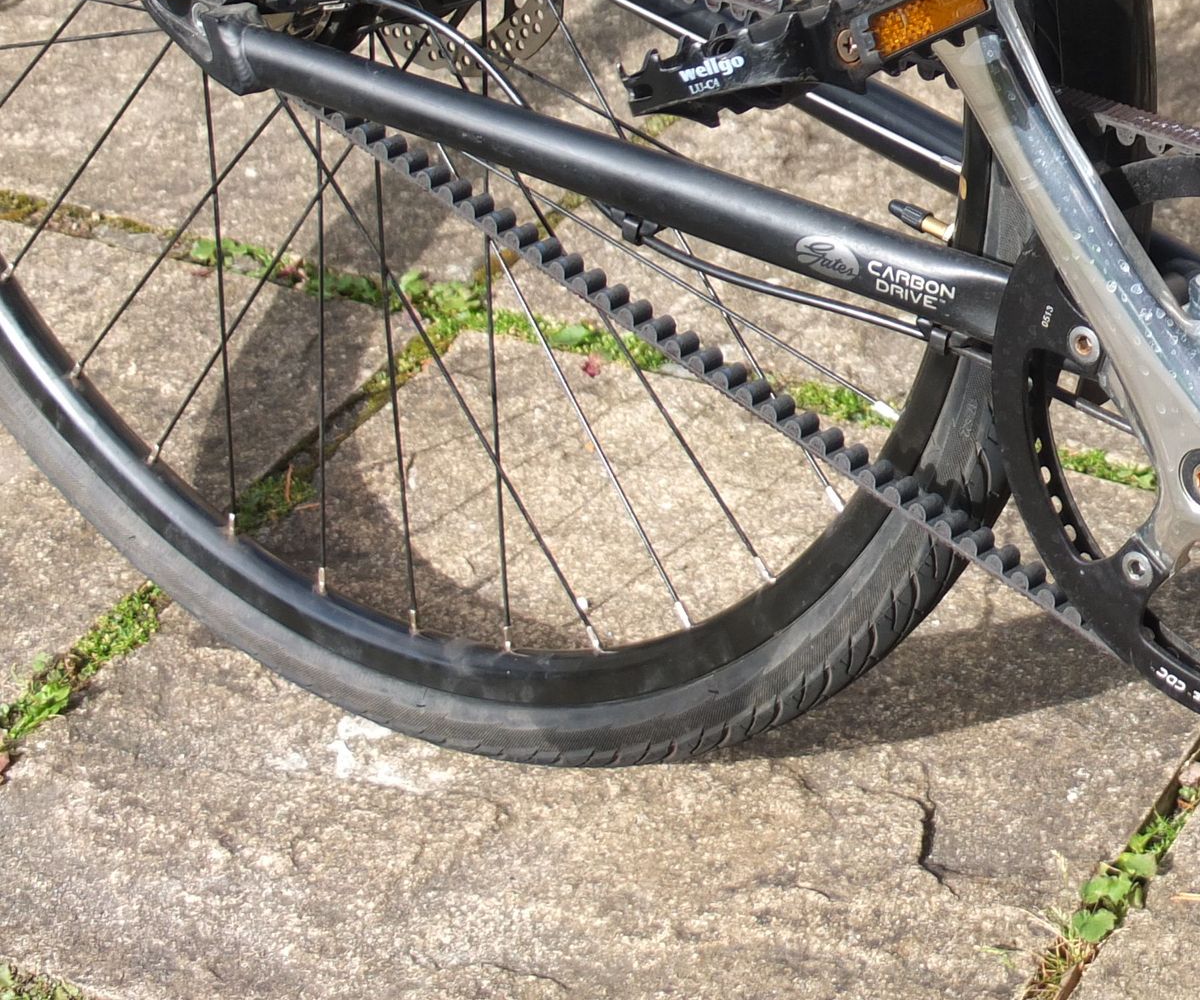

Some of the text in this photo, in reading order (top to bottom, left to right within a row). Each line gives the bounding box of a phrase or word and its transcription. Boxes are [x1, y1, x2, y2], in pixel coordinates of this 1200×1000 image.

[678, 55, 745, 83] wellgo
[802, 240, 858, 279] Gates
[867, 259, 956, 300] CARBON
[875, 277, 938, 310] DRIVE
